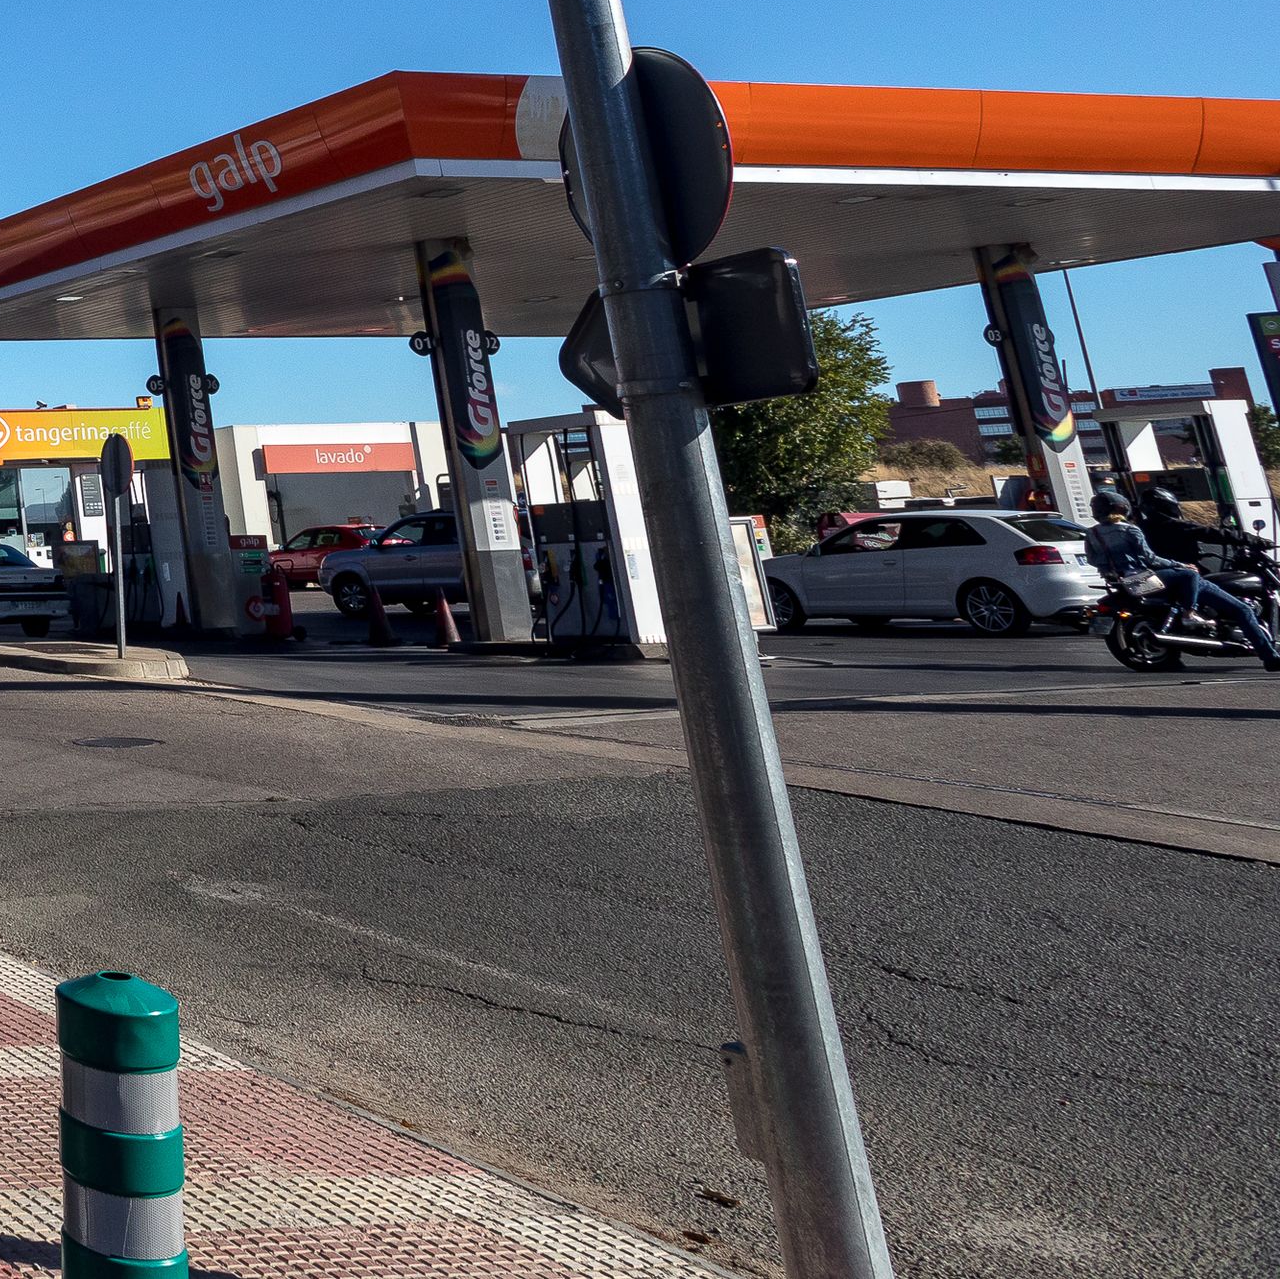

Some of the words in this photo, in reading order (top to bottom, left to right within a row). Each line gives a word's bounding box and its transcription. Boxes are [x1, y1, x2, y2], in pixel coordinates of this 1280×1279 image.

[188, 133, 284, 212] galp
[988, 330, 1002, 341] 03
[414, 337, 431, 350] 01
[150, 379, 165, 392] 05
[314, 446, 366, 465] lavado
[240, 536, 260, 548] galp
